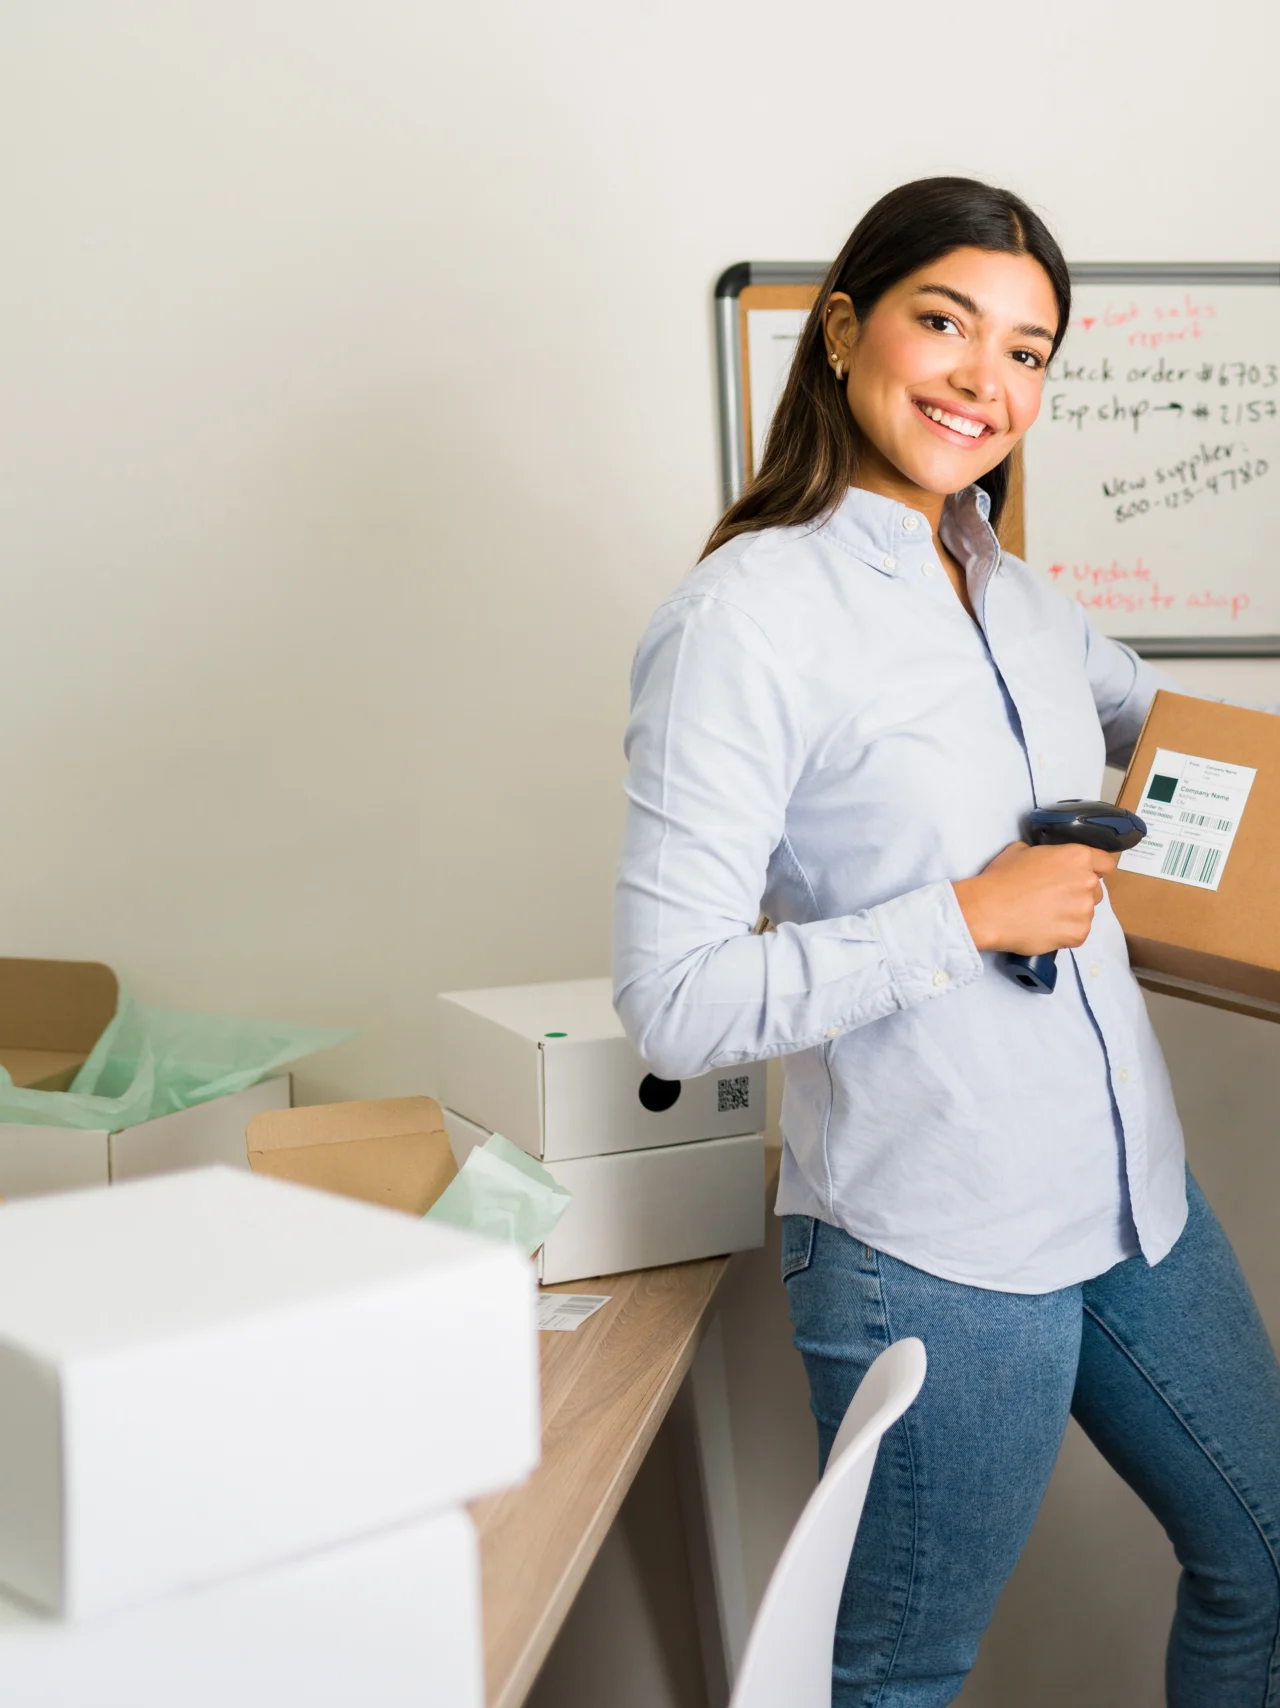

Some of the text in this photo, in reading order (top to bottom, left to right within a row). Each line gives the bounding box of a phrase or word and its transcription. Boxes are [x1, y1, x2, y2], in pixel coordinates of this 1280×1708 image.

[1103, 293, 1217, 327] Get sales
[1128, 321, 1204, 350] report
[1048, 357, 1279, 388] Check order #6703
[1102, 476, 1146, 498] New
[1073, 557, 1151, 586] Update
[1186, 590, 1251, 621] asap
[1180, 785, 1230, 802] Company Name
